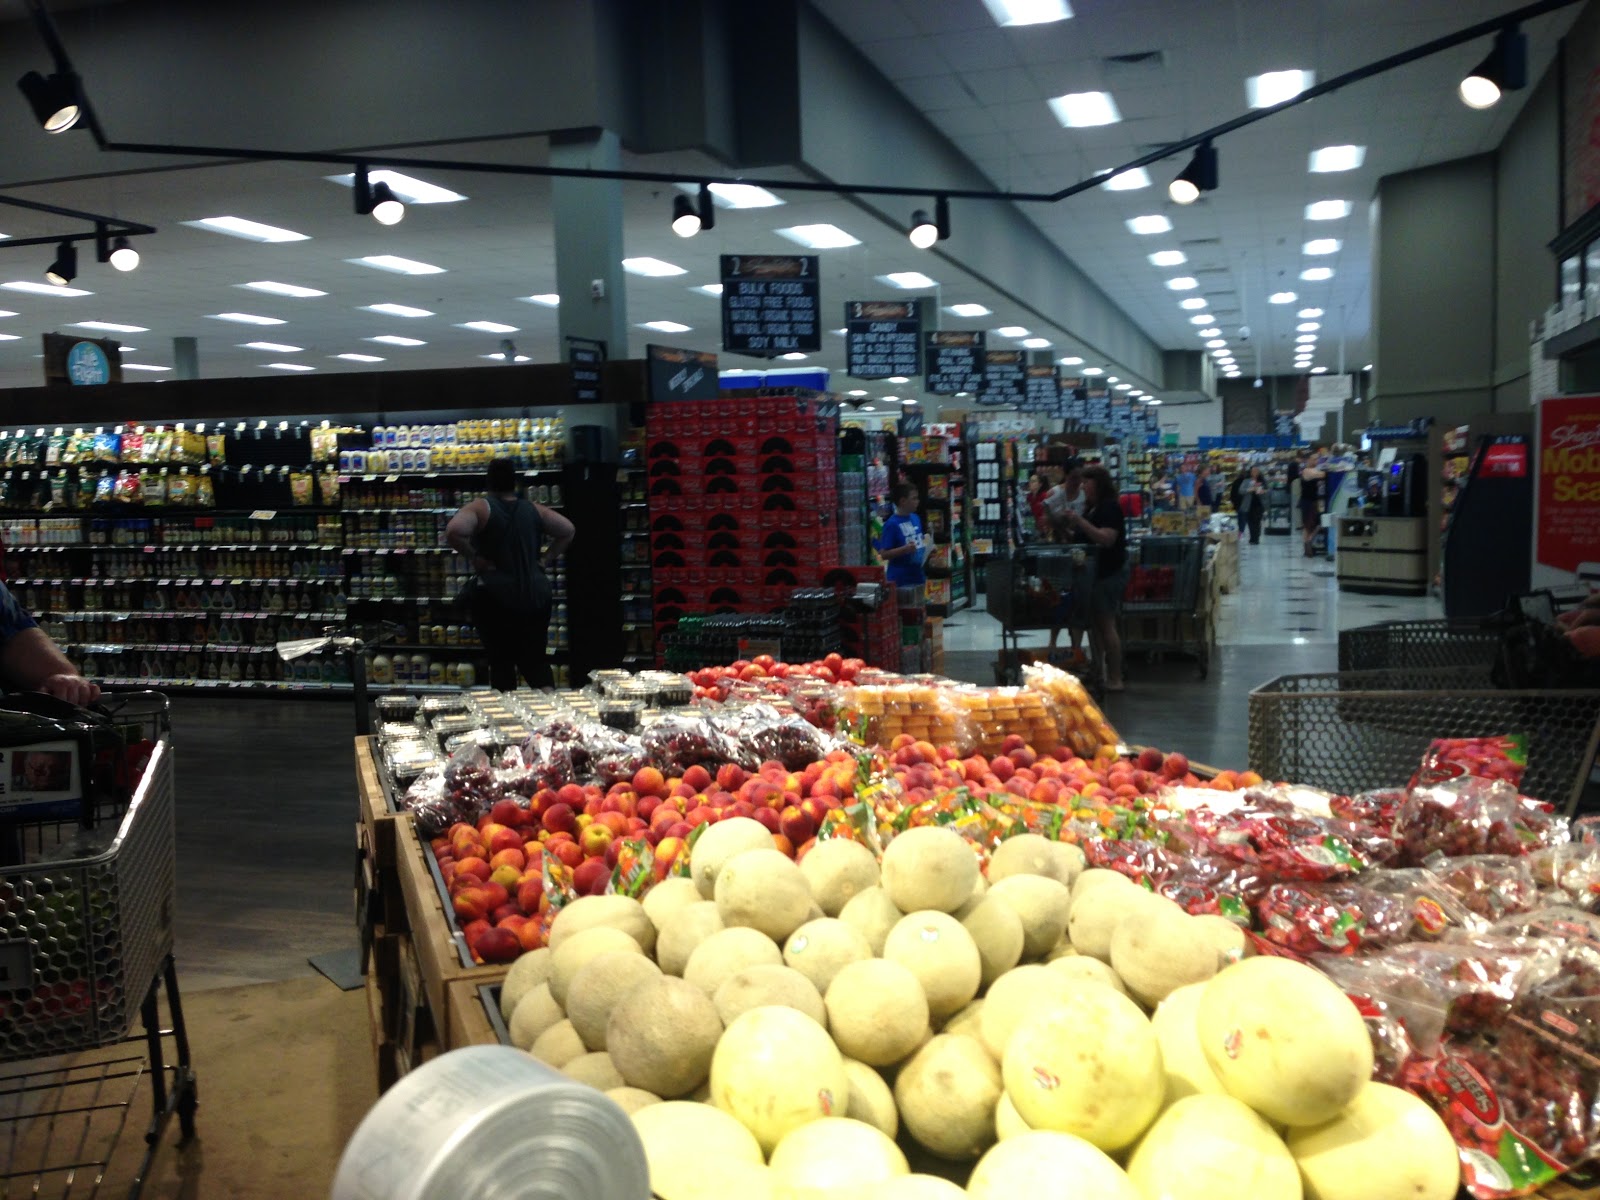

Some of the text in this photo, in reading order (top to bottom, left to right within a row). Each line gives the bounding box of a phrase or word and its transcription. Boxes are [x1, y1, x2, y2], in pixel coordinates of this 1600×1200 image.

[731, 256, 741, 275] 2
[799, 257, 809, 276] 2
[740, 282, 804, 295] BULK FOODS
[854, 302, 863, 318] 3
[906, 302, 914, 318] 3
[870, 322, 897, 333] CANDY
[748, 336, 799, 348] SOY MILK
